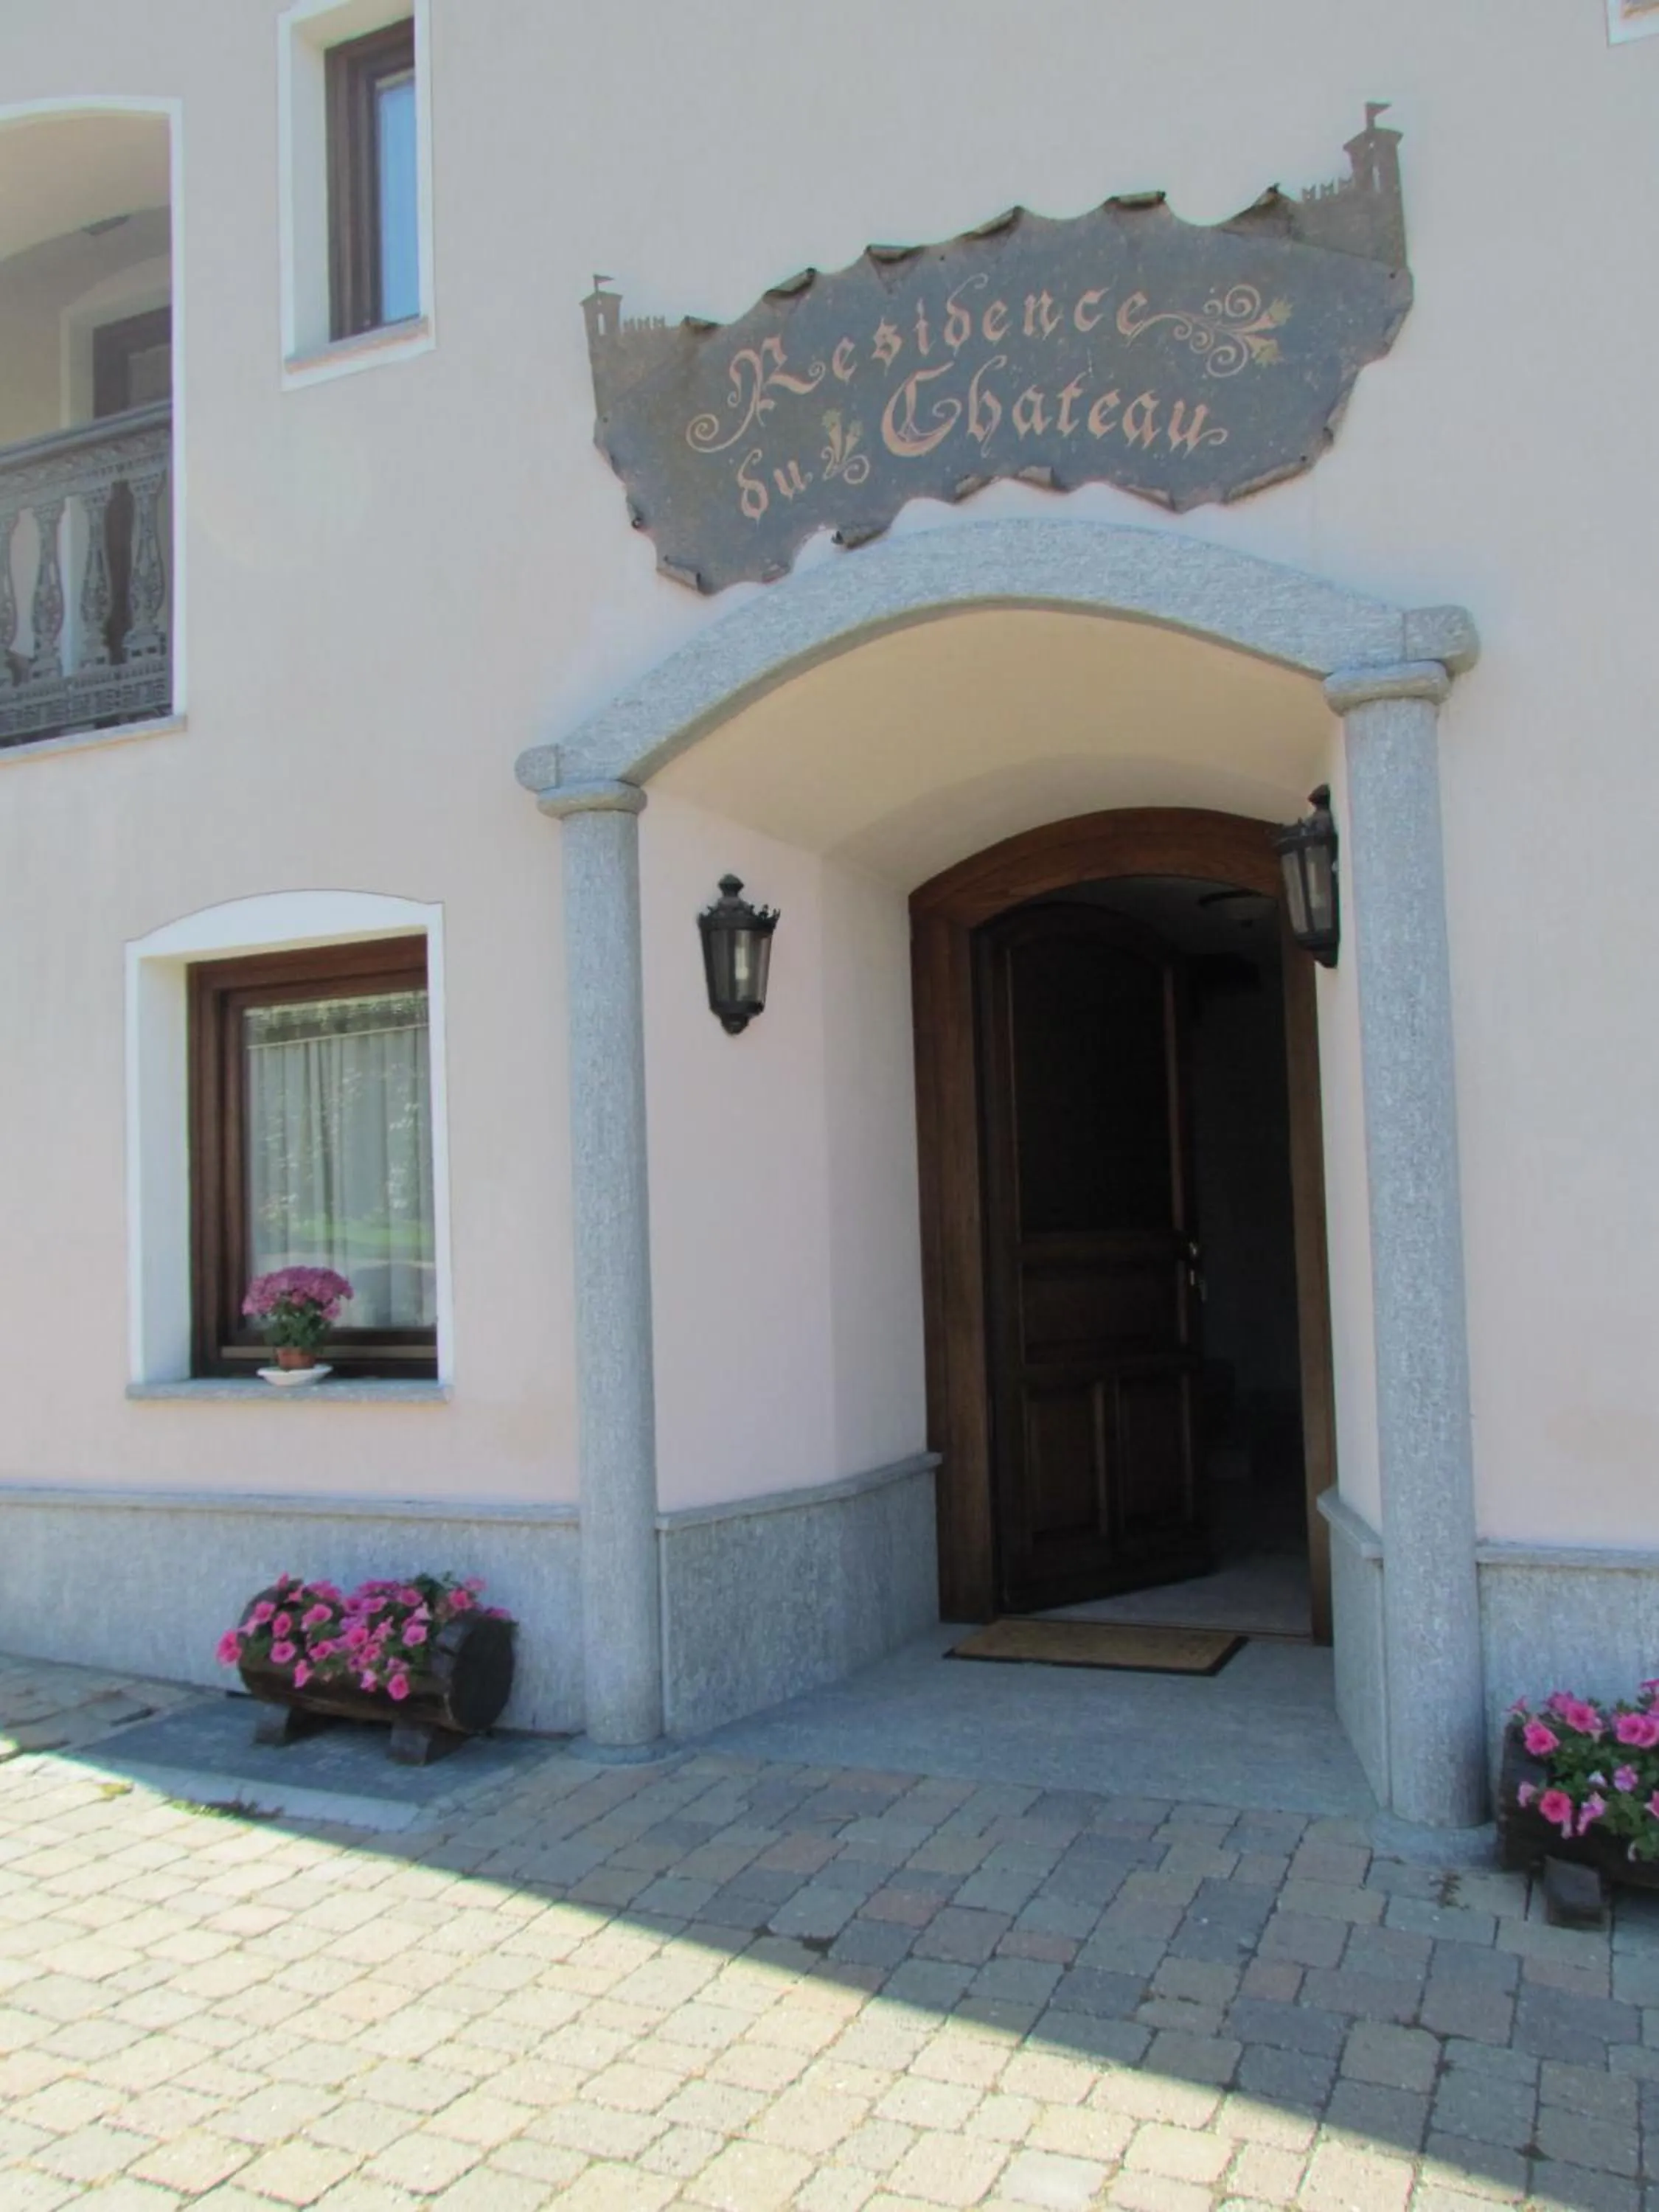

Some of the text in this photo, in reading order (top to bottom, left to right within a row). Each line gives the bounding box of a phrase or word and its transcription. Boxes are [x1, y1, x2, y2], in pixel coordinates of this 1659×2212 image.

[686, 274, 1152, 453] Residence
[737, 355, 1228, 524] du Chateau
